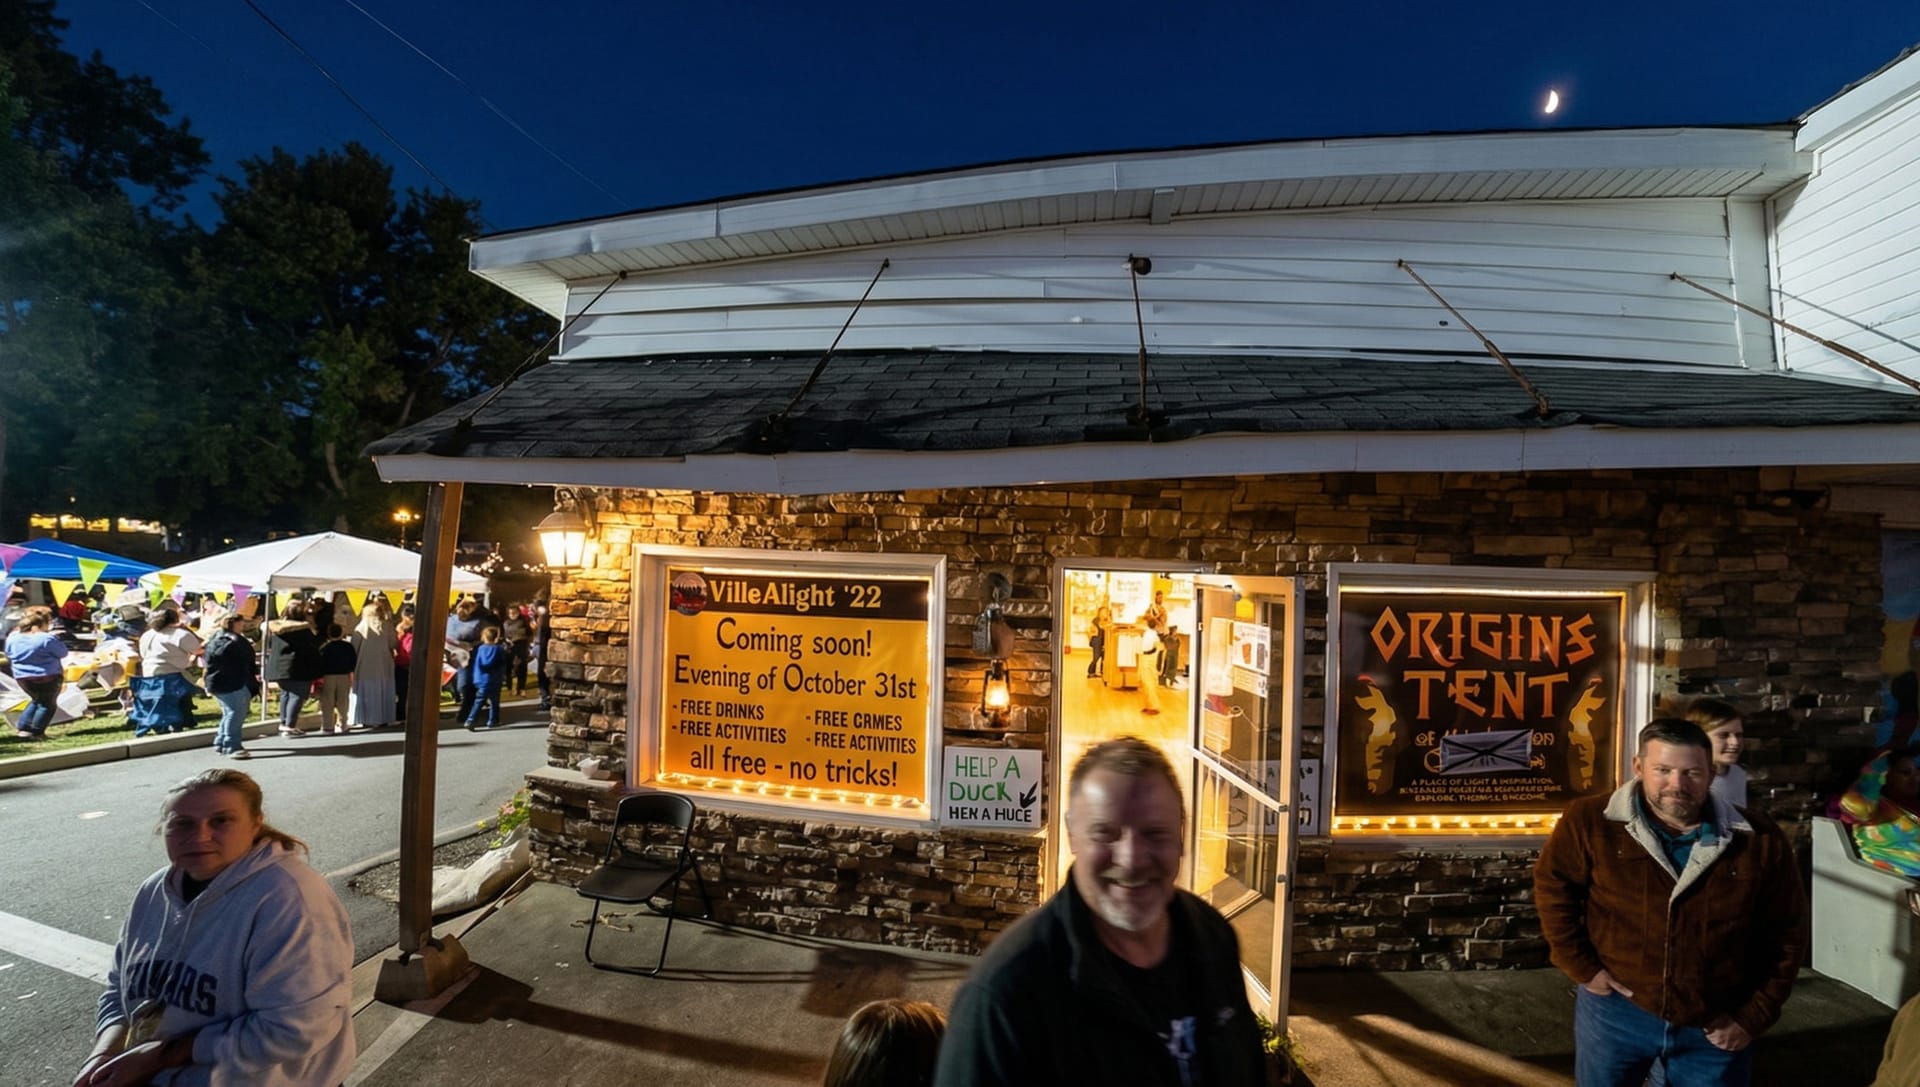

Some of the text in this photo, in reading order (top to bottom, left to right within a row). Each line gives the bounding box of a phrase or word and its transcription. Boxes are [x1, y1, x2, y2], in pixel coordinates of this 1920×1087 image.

[844, 584, 882, 608] '22
[716, 616, 872, 660] Coming soon!
[1370, 605, 1597, 668] ORIGINS
[674, 654, 917, 700] Evening of October 31st
[1403, 670, 1569, 721] TENT
[680, 699, 711, 717] FREE
[715, 701, 765, 721] DRINKS
[814, 710, 849, 728] FREE
[680, 720, 711, 738] FREE
[715, 723, 787, 744] ACTIVITIES
[814, 732, 846, 749] FREE
[850, 735, 917, 755] ACTIVITIES
[691, 744, 714, 770] all
[722, 745, 767, 775] free
[789, 764, 817, 781] no
[825, 759, 898, 787] tricks!
[956, 754, 1021, 778] HELP A
[949, 782, 1013, 803] DUCK
[1464, 778, 1490, 786] LIGHT
[981, 808, 991, 820] A
